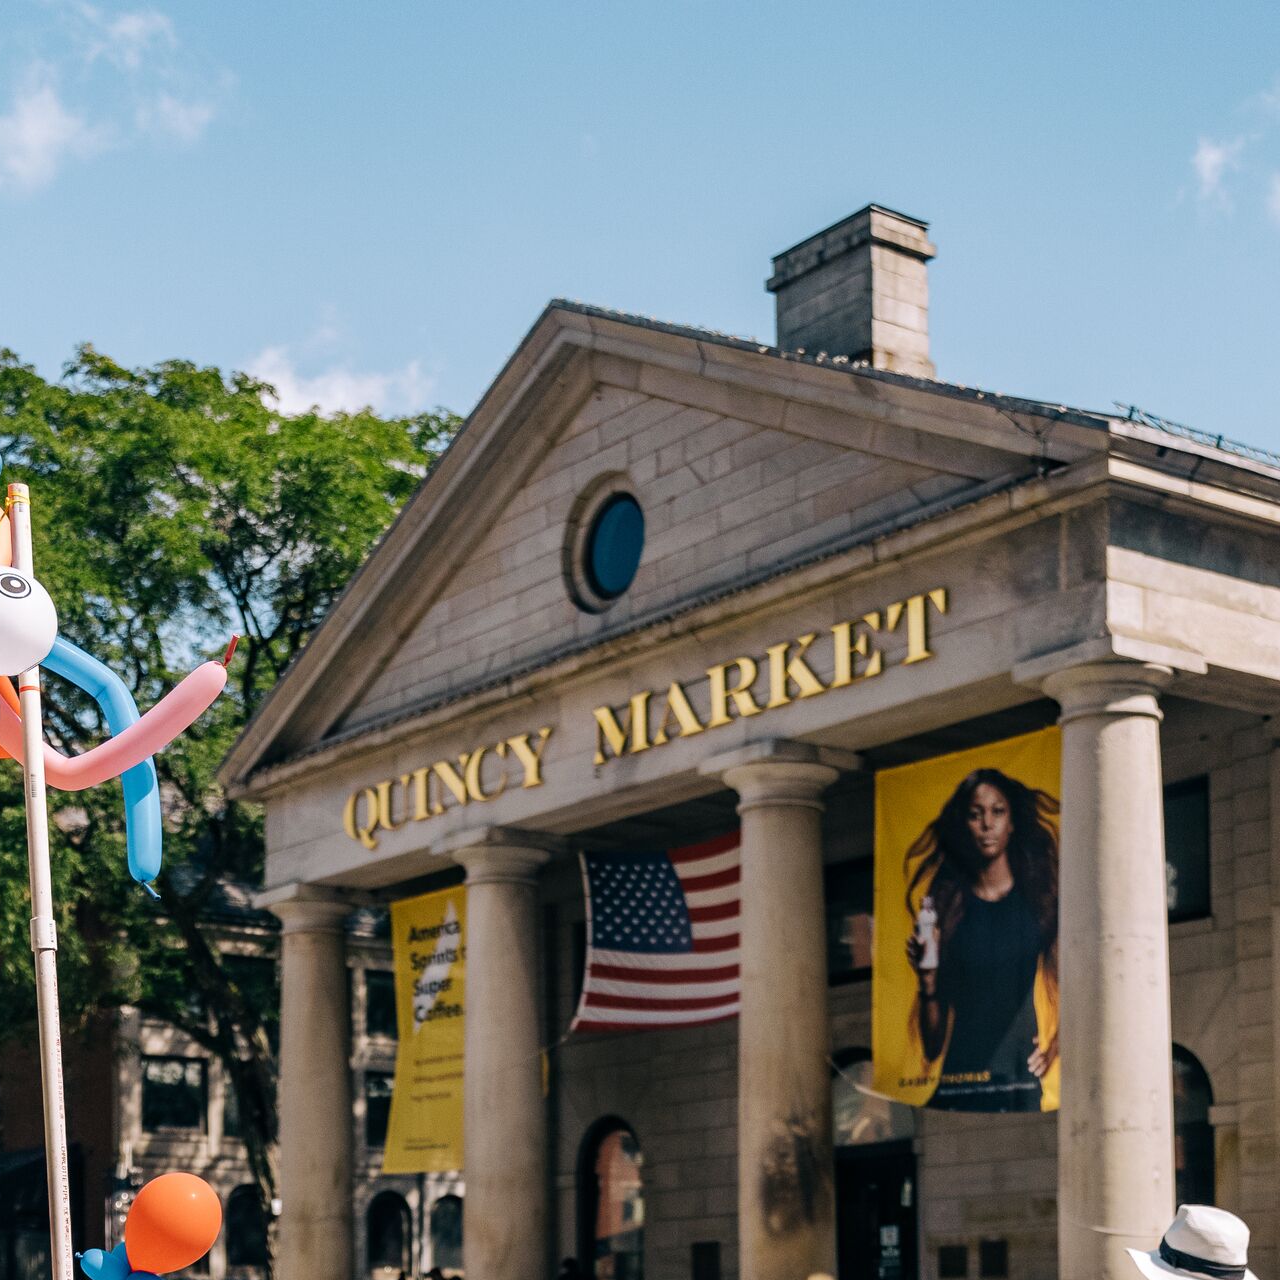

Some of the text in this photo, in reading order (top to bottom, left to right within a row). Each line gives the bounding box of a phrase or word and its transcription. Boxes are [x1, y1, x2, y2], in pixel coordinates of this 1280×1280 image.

[343, 587, 949, 850] QUINCY MARKET
[412, 978, 453, 997] Super
